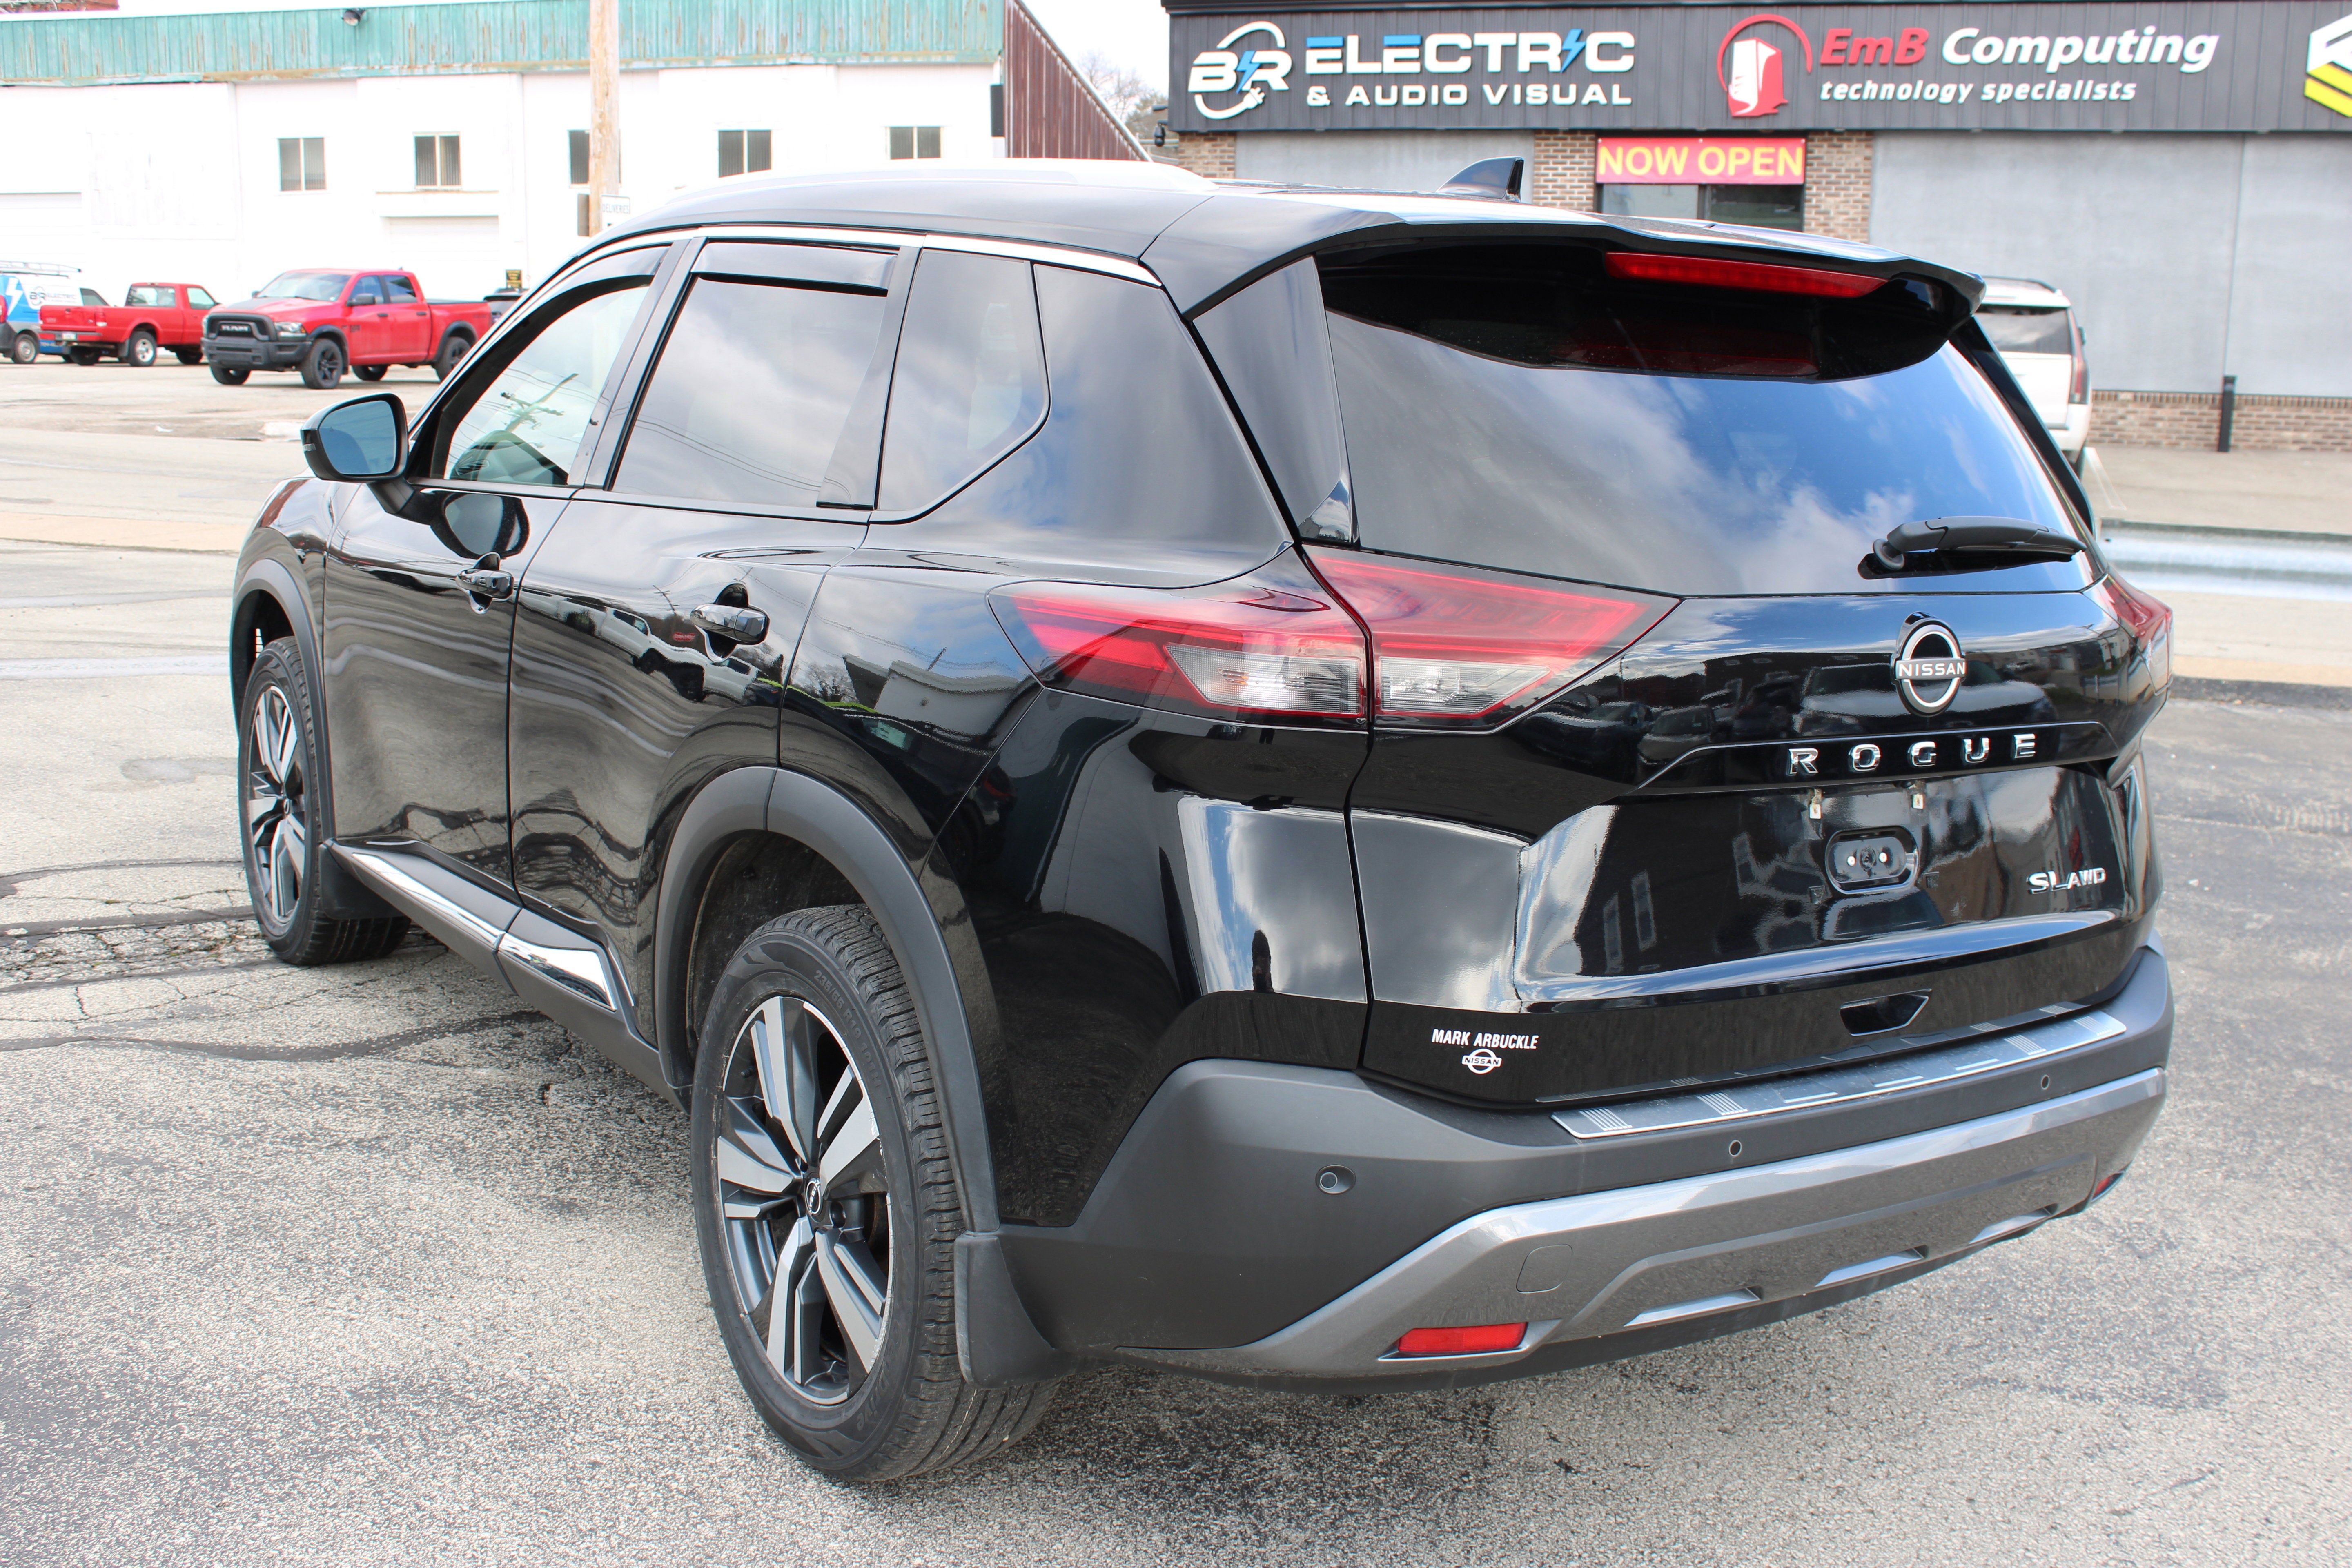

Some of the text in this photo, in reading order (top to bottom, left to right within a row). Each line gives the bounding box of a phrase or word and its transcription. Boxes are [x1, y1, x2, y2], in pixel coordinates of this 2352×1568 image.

[1306, 28, 1635, 74] ELECTRIC
[1820, 25, 2220, 74] EmB Computing
[1307, 83, 1633, 107] & AUDIO VISUAL
[1820, 80, 2137, 104] technology specialists
[1598, 146, 1804, 176] NOW OPEN
[1899, 662, 1966, 677] NISSAN
[1787, 733, 2036, 775] ROGUE
[814, 968, 845, 1010] 235/55
[843, 1007, 862, 1040] R19
[1431, 1029, 1539, 1049] MARK ARBUCKLE
[1465, 1057, 1499, 1065] NISSAN
